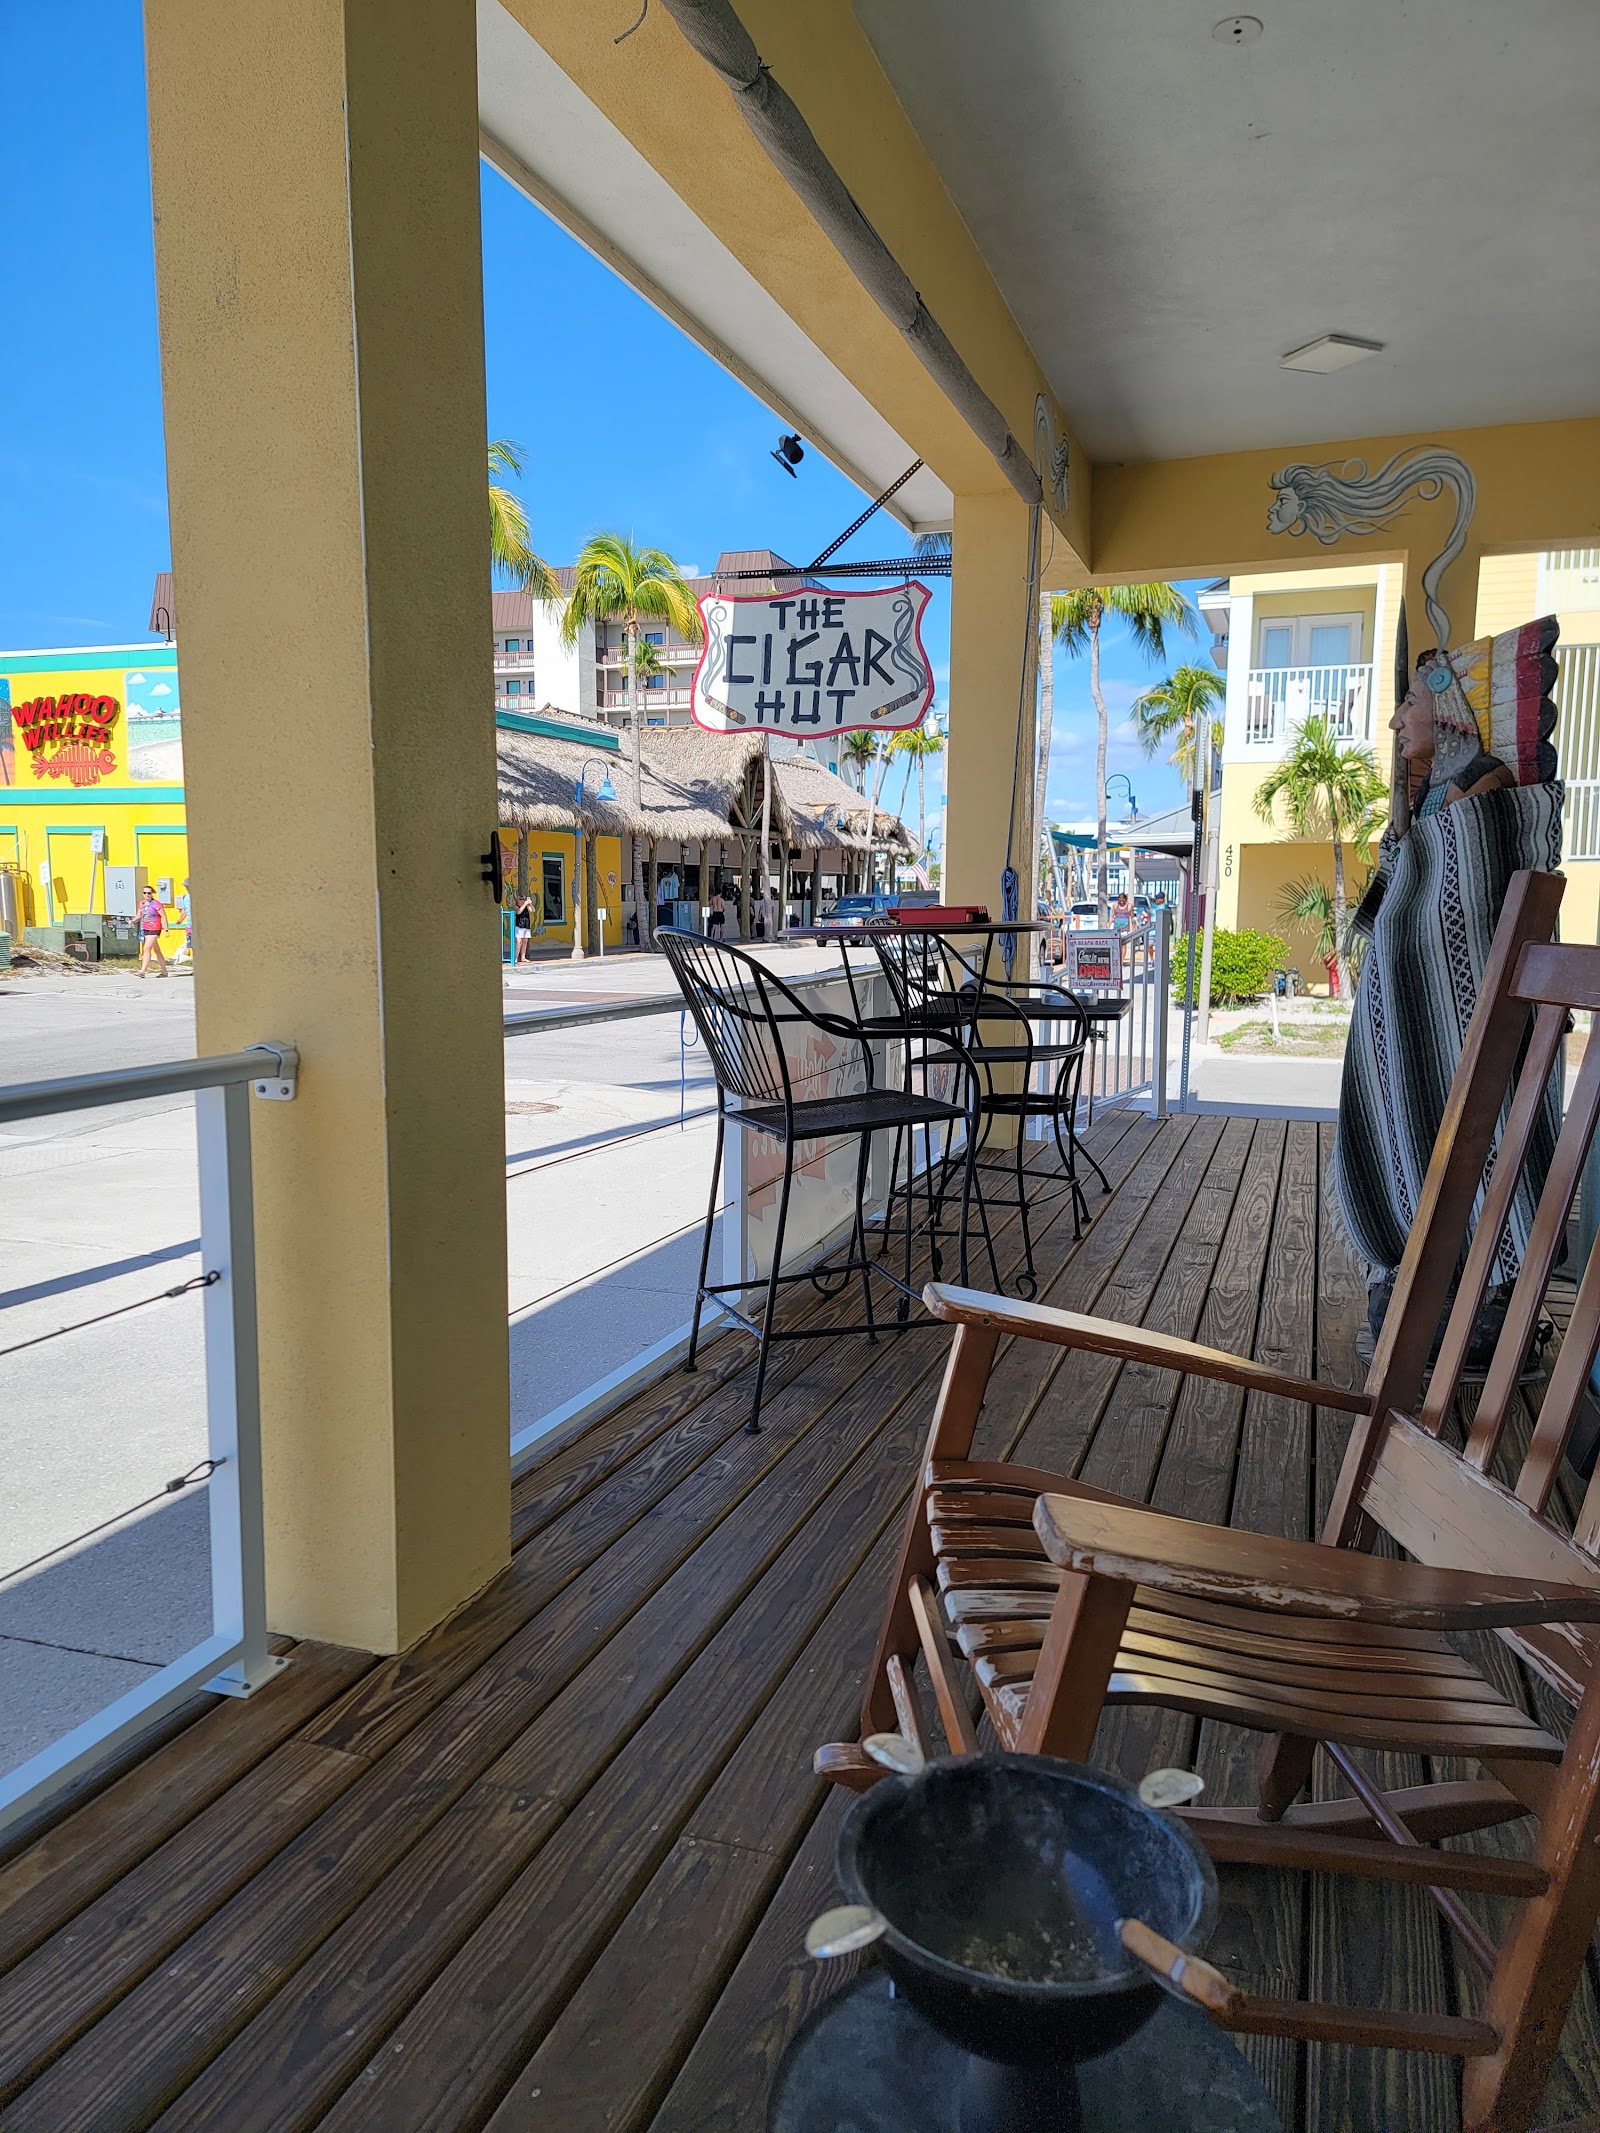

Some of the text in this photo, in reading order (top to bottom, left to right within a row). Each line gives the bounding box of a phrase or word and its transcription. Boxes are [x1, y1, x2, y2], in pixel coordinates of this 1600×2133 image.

[769, 598, 845, 630] THE
[722, 628, 895, 687] CIGAR
[11, 693, 117, 727] WAHOO
[755, 689, 855, 724] HUT
[22, 721, 110, 751] WILLIES
[1225, 844, 1233, 877] 450
[1078, 965, 1109, 978] OPEN
